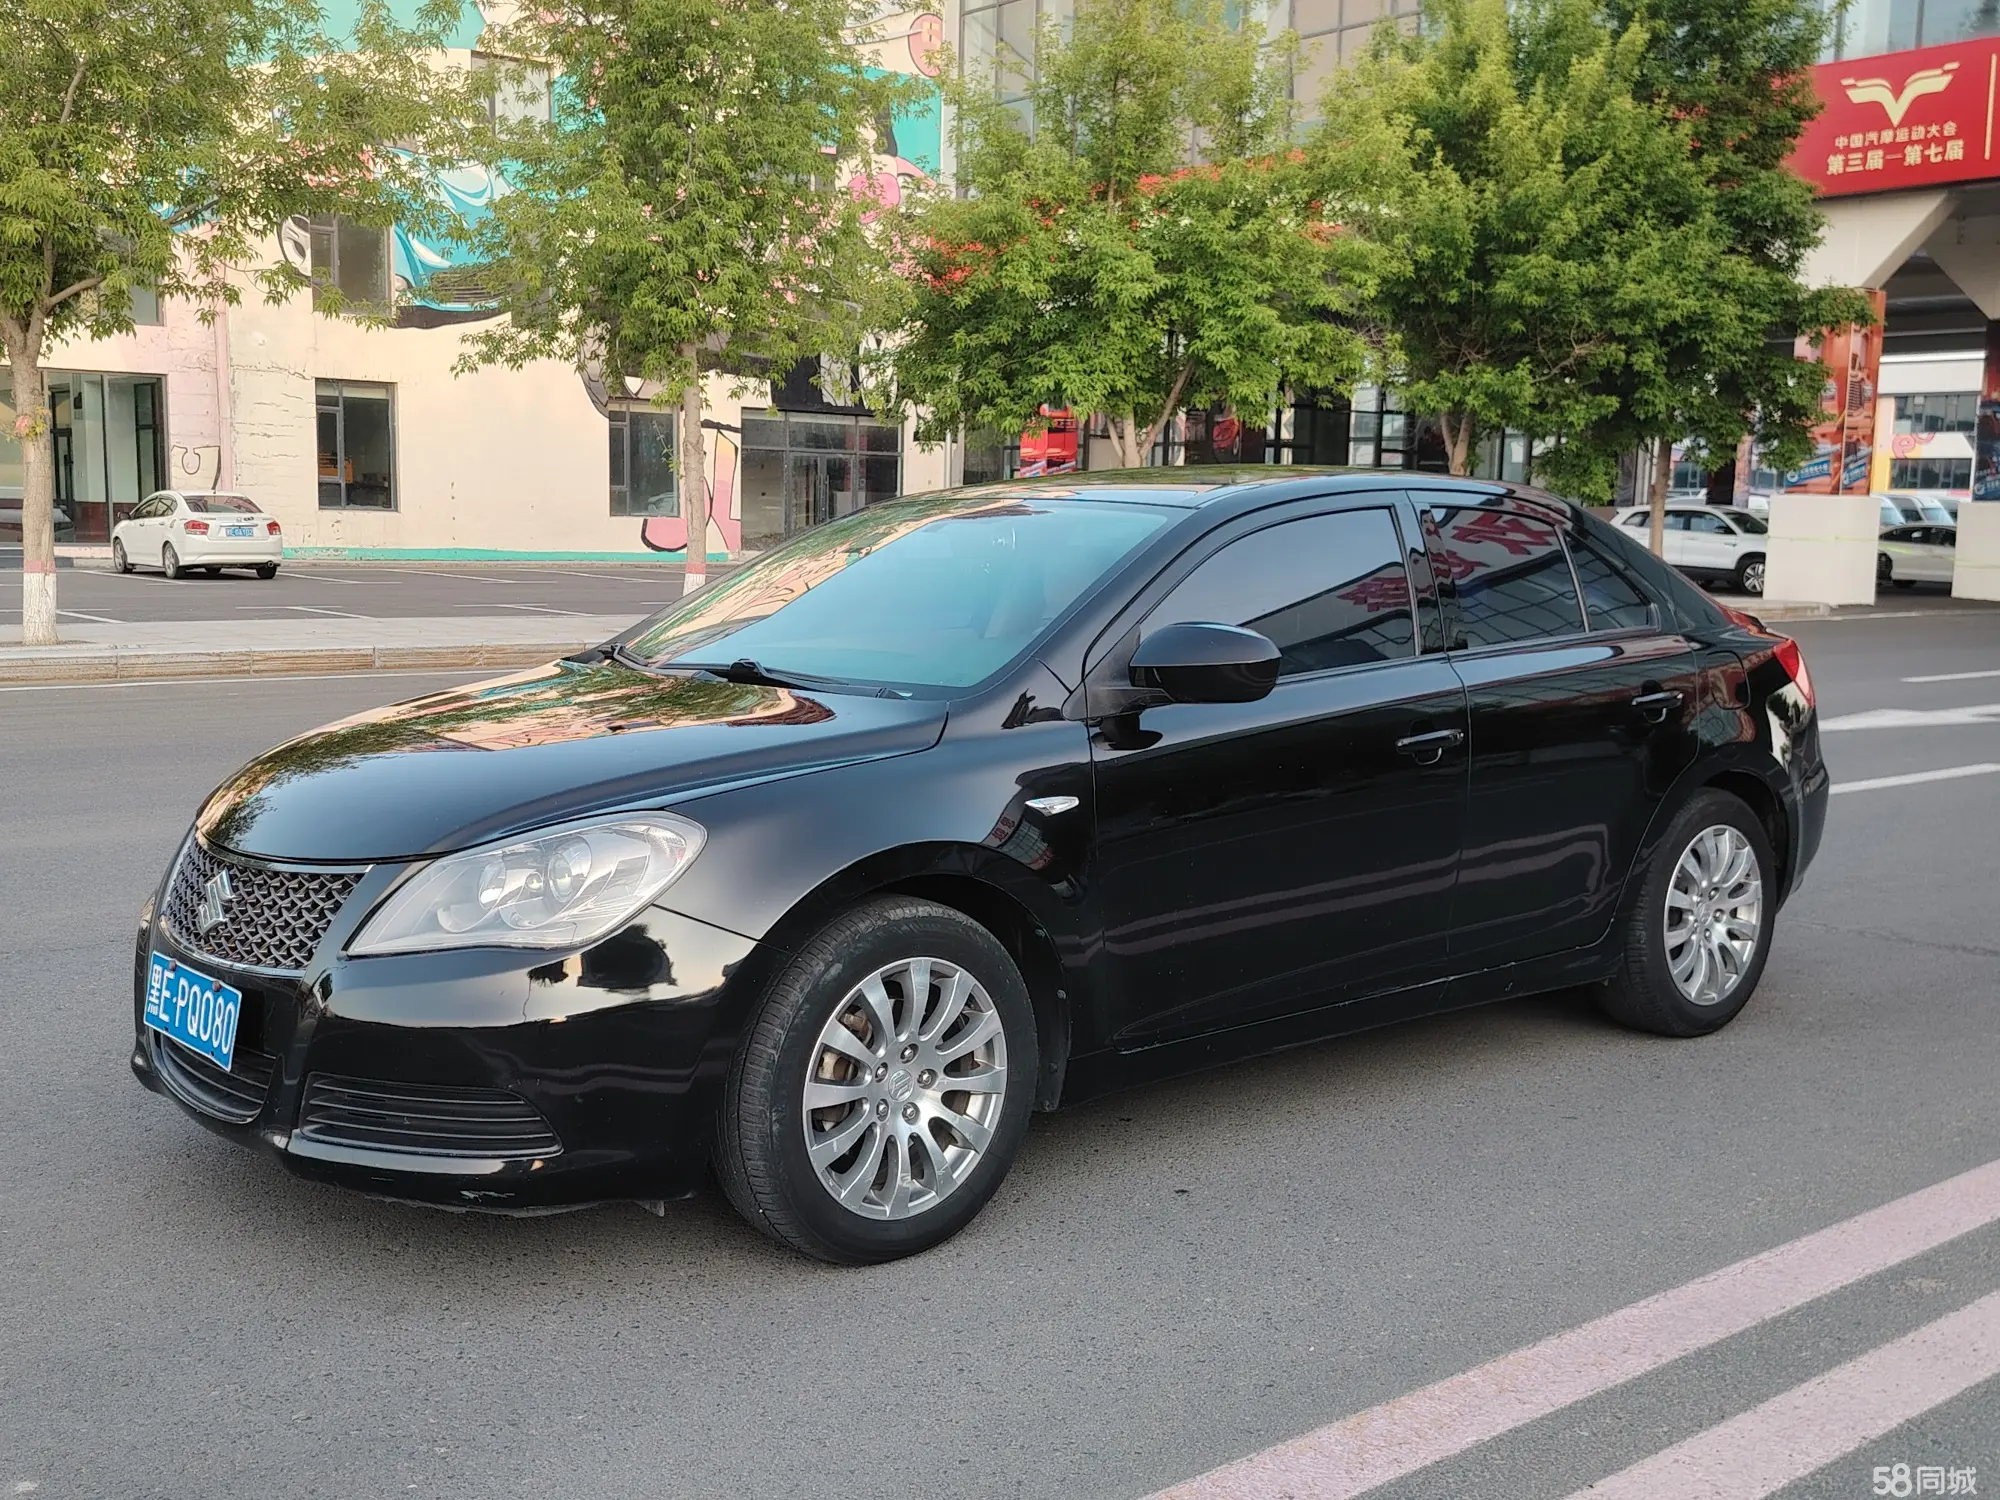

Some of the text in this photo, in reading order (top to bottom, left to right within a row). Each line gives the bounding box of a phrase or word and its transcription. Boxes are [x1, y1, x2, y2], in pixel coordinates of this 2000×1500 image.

[1834, 120, 1957, 150] 中国汽摩运动大会
